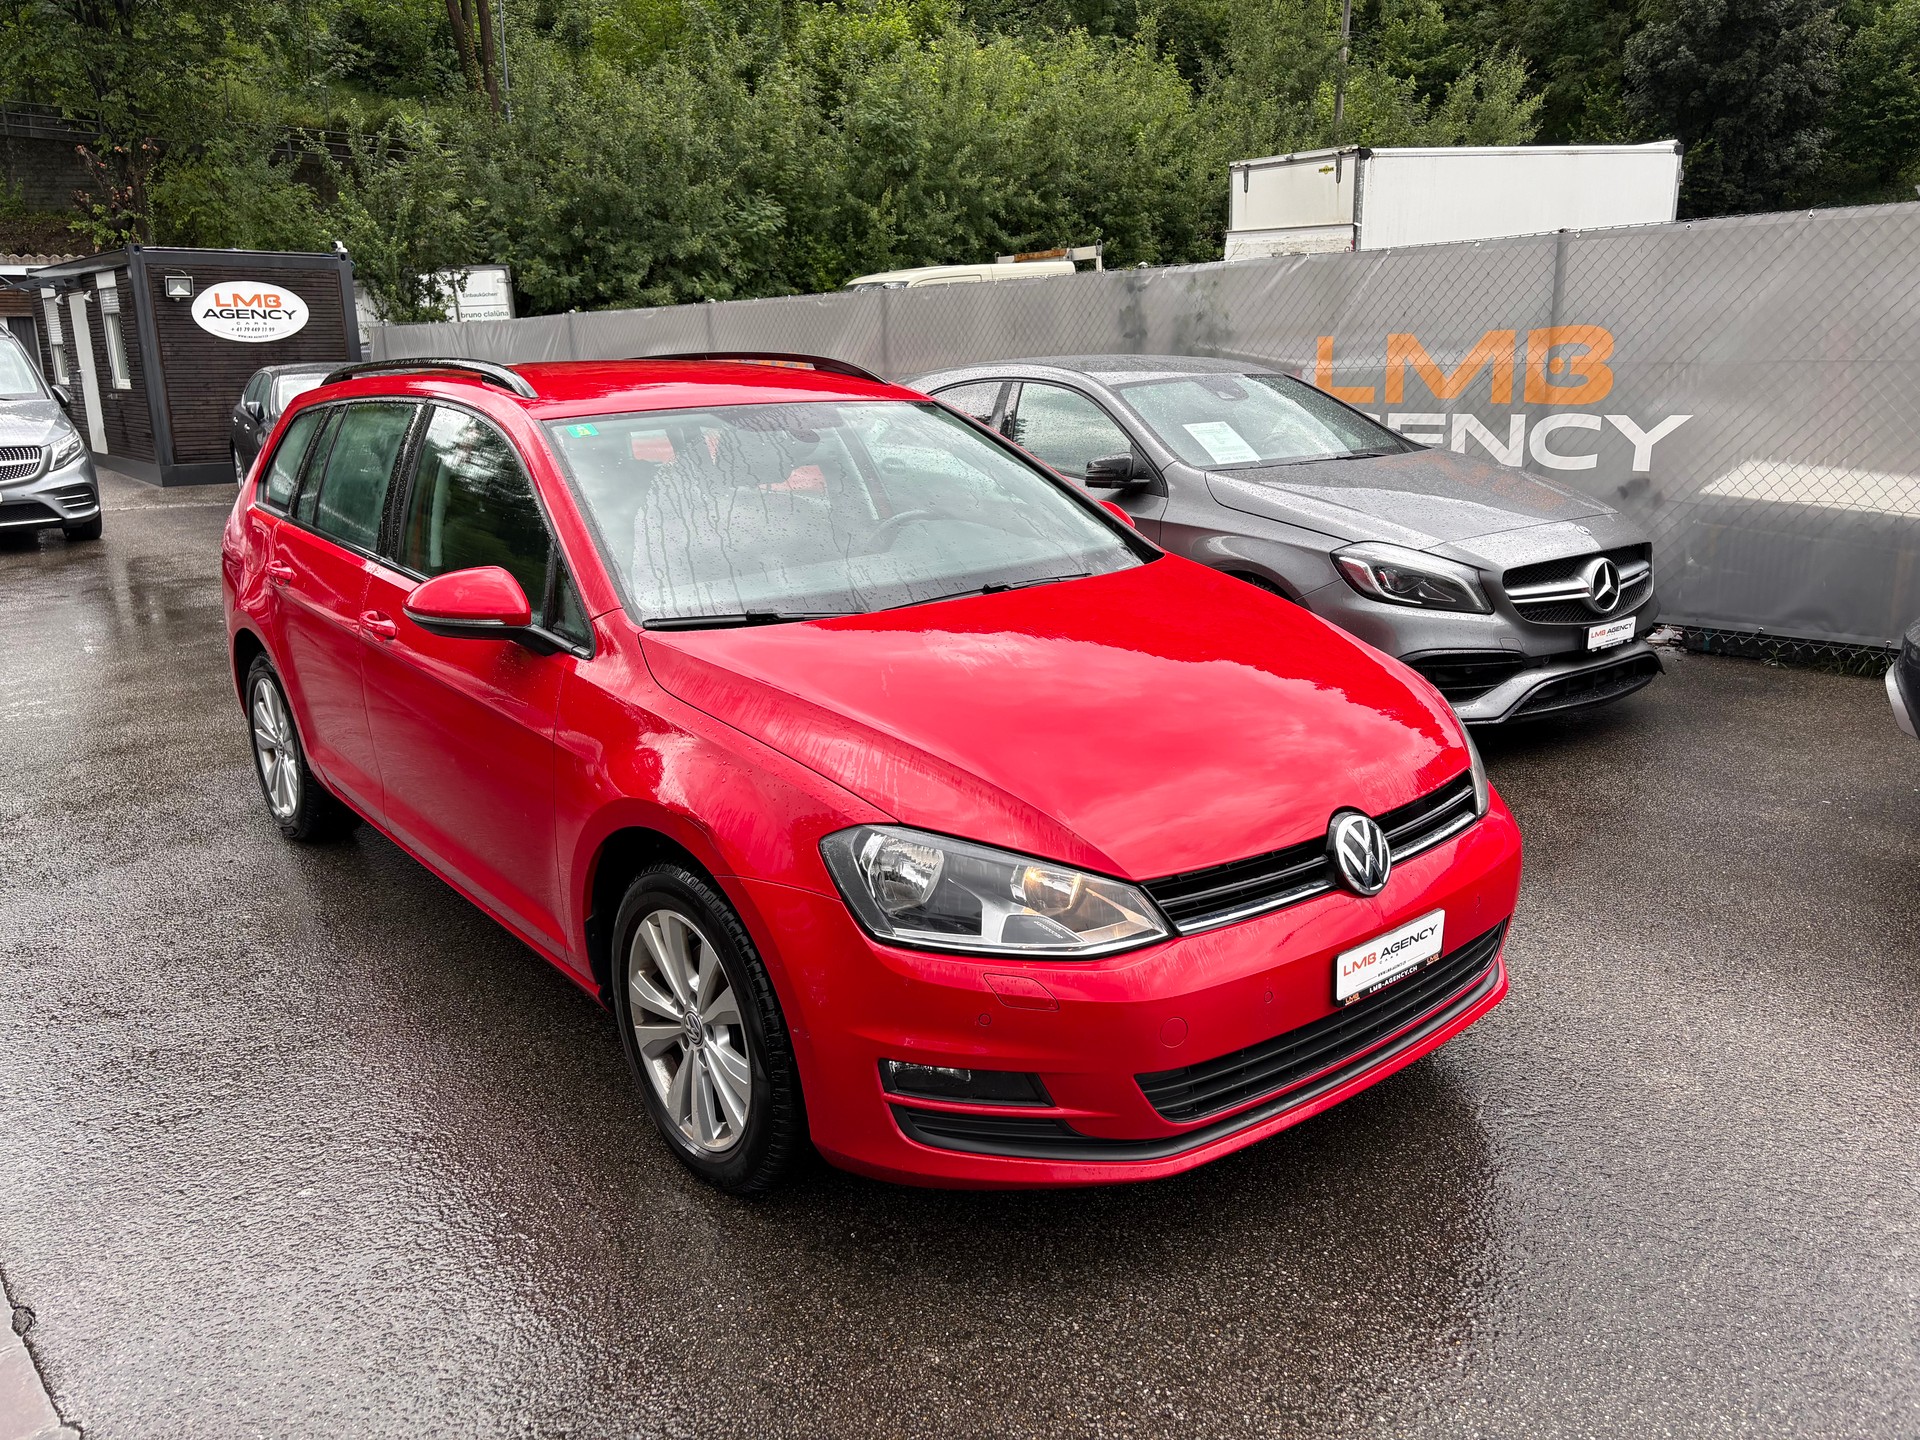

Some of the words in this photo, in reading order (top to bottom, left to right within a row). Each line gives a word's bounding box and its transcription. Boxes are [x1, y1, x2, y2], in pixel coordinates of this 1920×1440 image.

[202, 308, 297, 320] AGENCY
[214, 293, 282, 308] LMB
[1314, 324, 1615, 405] LMB
[1365, 412, 1694, 472] ENCY
[1607, 623, 1633, 634] AGENCY
[1343, 951, 1377, 977] LMB
[1380, 924, 1438, 959] AGENCY
[1369, 965, 1418, 993] LMB-AGENCY.CH
